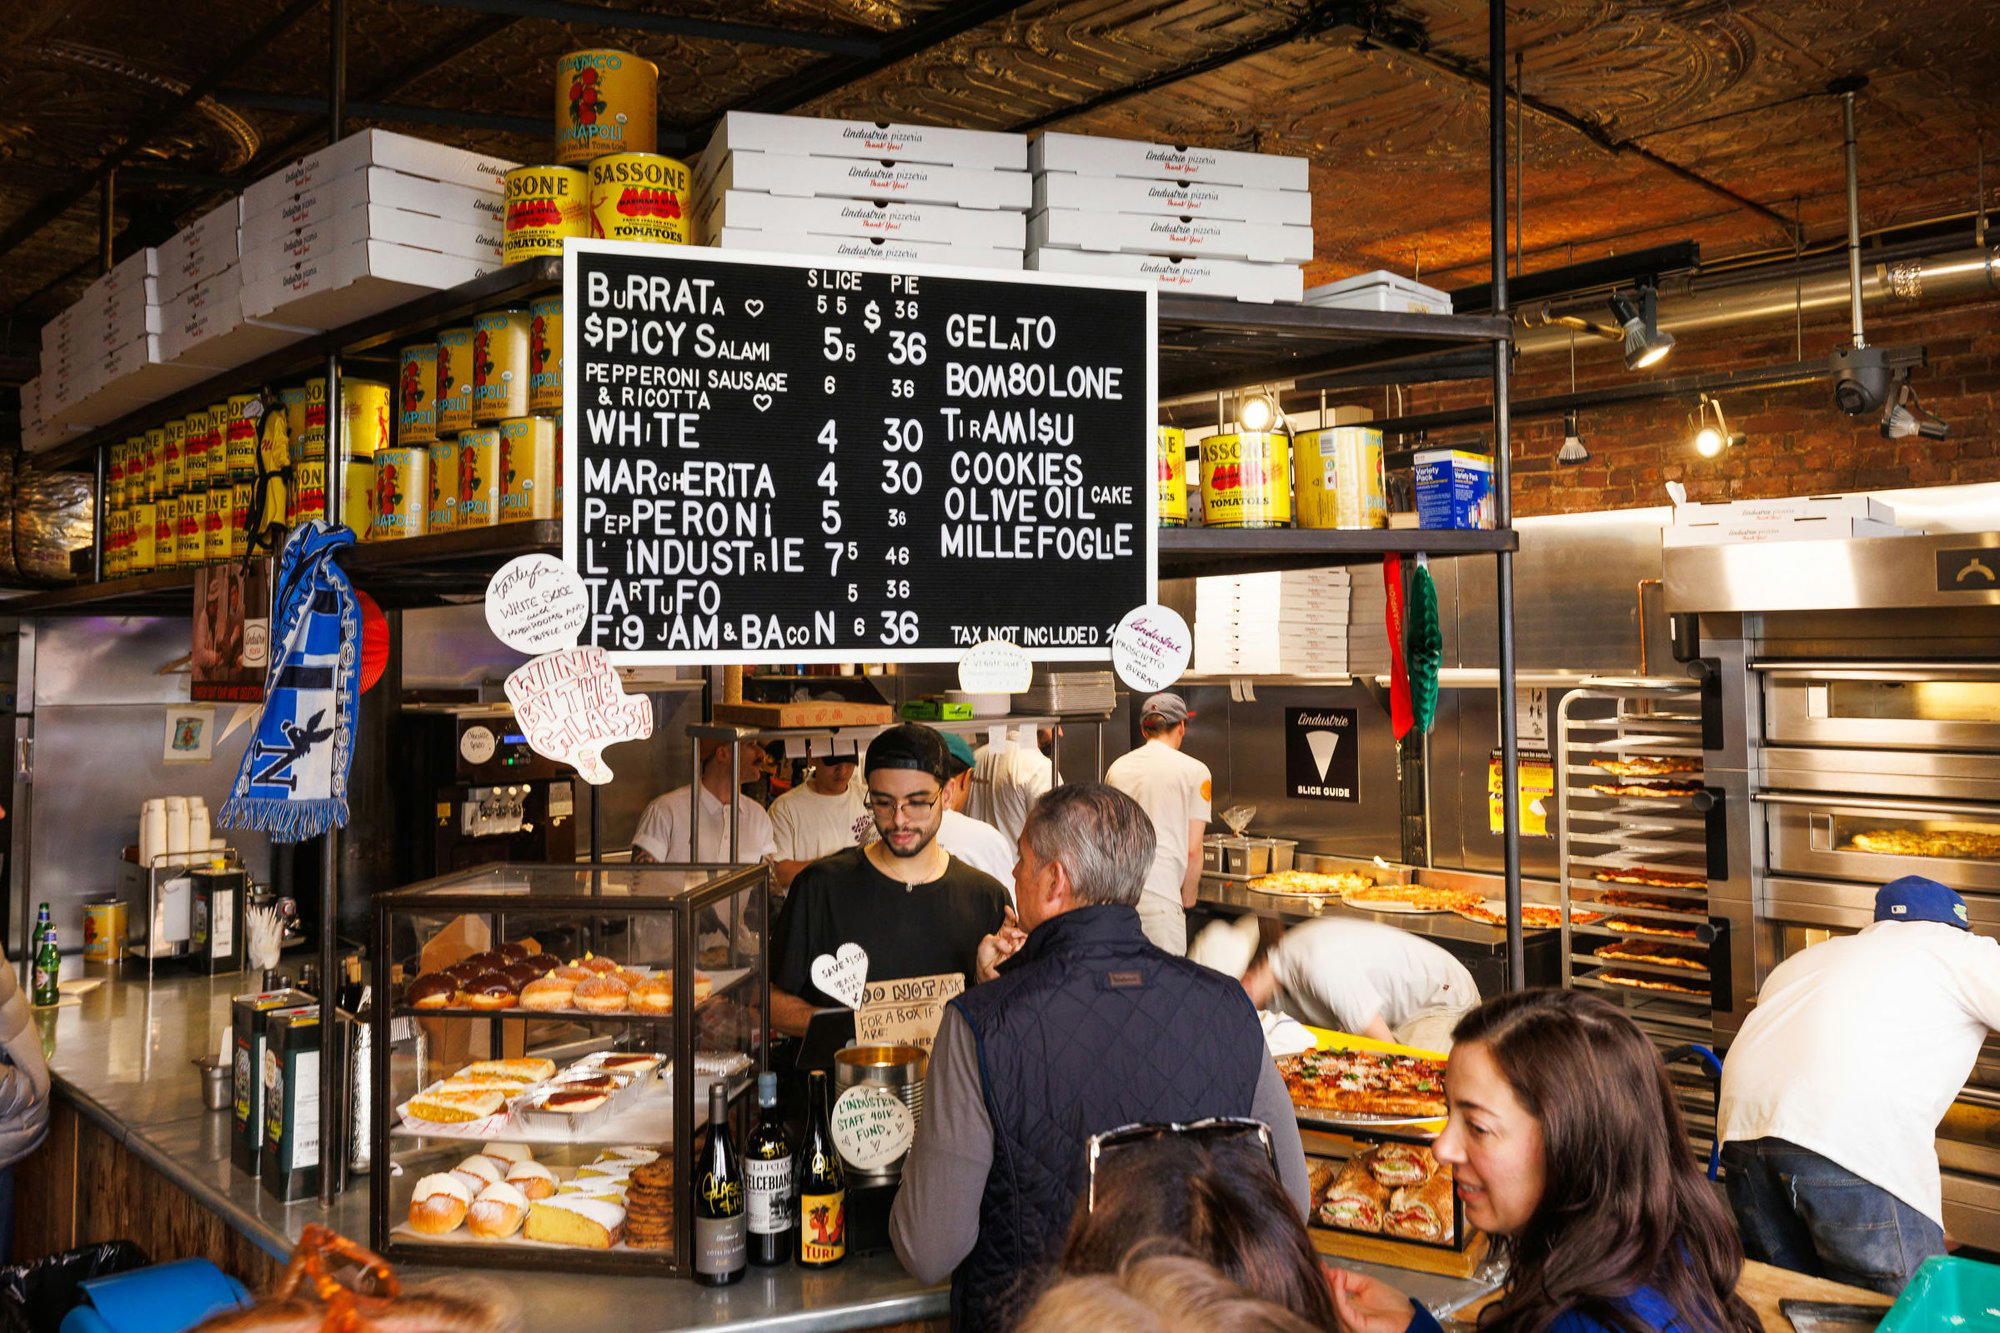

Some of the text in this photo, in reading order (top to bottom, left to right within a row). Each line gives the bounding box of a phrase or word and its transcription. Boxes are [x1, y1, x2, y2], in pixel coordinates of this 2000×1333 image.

[593, 162, 685, 191] SASSONE
[614, 225, 683, 243] TOMATOES
[588, 271, 725, 316] BURRATA
[895, 300, 919, 319] 36
[808, 269, 919, 295] SLICE PIE
[694, 323, 770, 362] SALAMI
[888, 331, 927, 367] 36
[945, 313, 1057, 351] GELATO
[586, 363, 914, 398] PEPPERONI SAUSAGE 6 36
[598, 386, 711, 411] & RICOTTA
[586, 408, 924, 454] WHITE 4 30
[817, 461, 838, 496] 4
[881, 459, 923, 496] 30
[950, 450, 1084, 487] COOKIES
[821, 500, 842, 535] 5
[888, 509, 906, 528] 36
[1044, 486, 1096, 520] OIL
[1090, 485, 1133, 505] CAKE
[884, 547, 910, 566] 46
[583, 578, 910, 617] TARTUFO 5 36
[656, 615, 719, 650] JAM
[723, 622, 738, 642] &
[742, 611, 836, 650] BACON
[853, 618, 866, 637] 6
[880, 610, 920, 646] 36
[951, 626, 1099, 646] TAX NOT INCLUDED
[508, 649, 608, 702] WINE
[555, 671, 619, 716] THE
[1297, 785, 1350, 798] SLICE GUIDE
[892, 979, 936, 1001] NOT
[938, 976, 962, 997] ASK
[860, 1006, 934, 1032] FOR A BOX IF
[837, 1114, 865, 1132] STAFF
[856, 1124, 887, 1142] FUND
